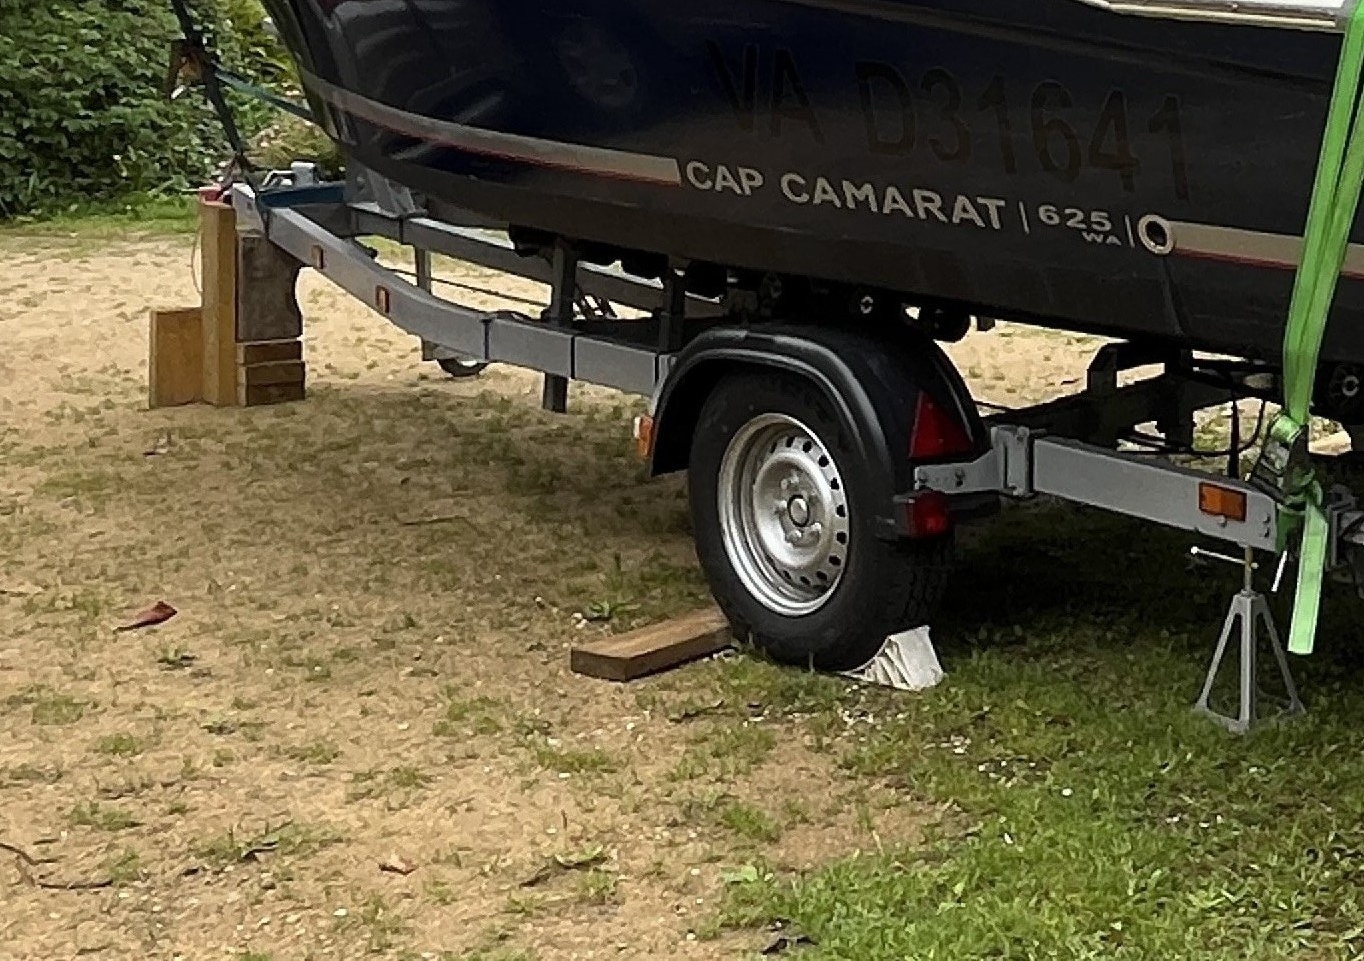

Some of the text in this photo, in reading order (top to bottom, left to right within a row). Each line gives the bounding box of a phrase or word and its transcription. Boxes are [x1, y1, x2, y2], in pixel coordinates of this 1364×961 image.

[704, 40, 1192, 202] VA D31641
[686, 160, 1112, 232] CAP CAMARAT 625
[1081, 231, 1122, 246] WA
